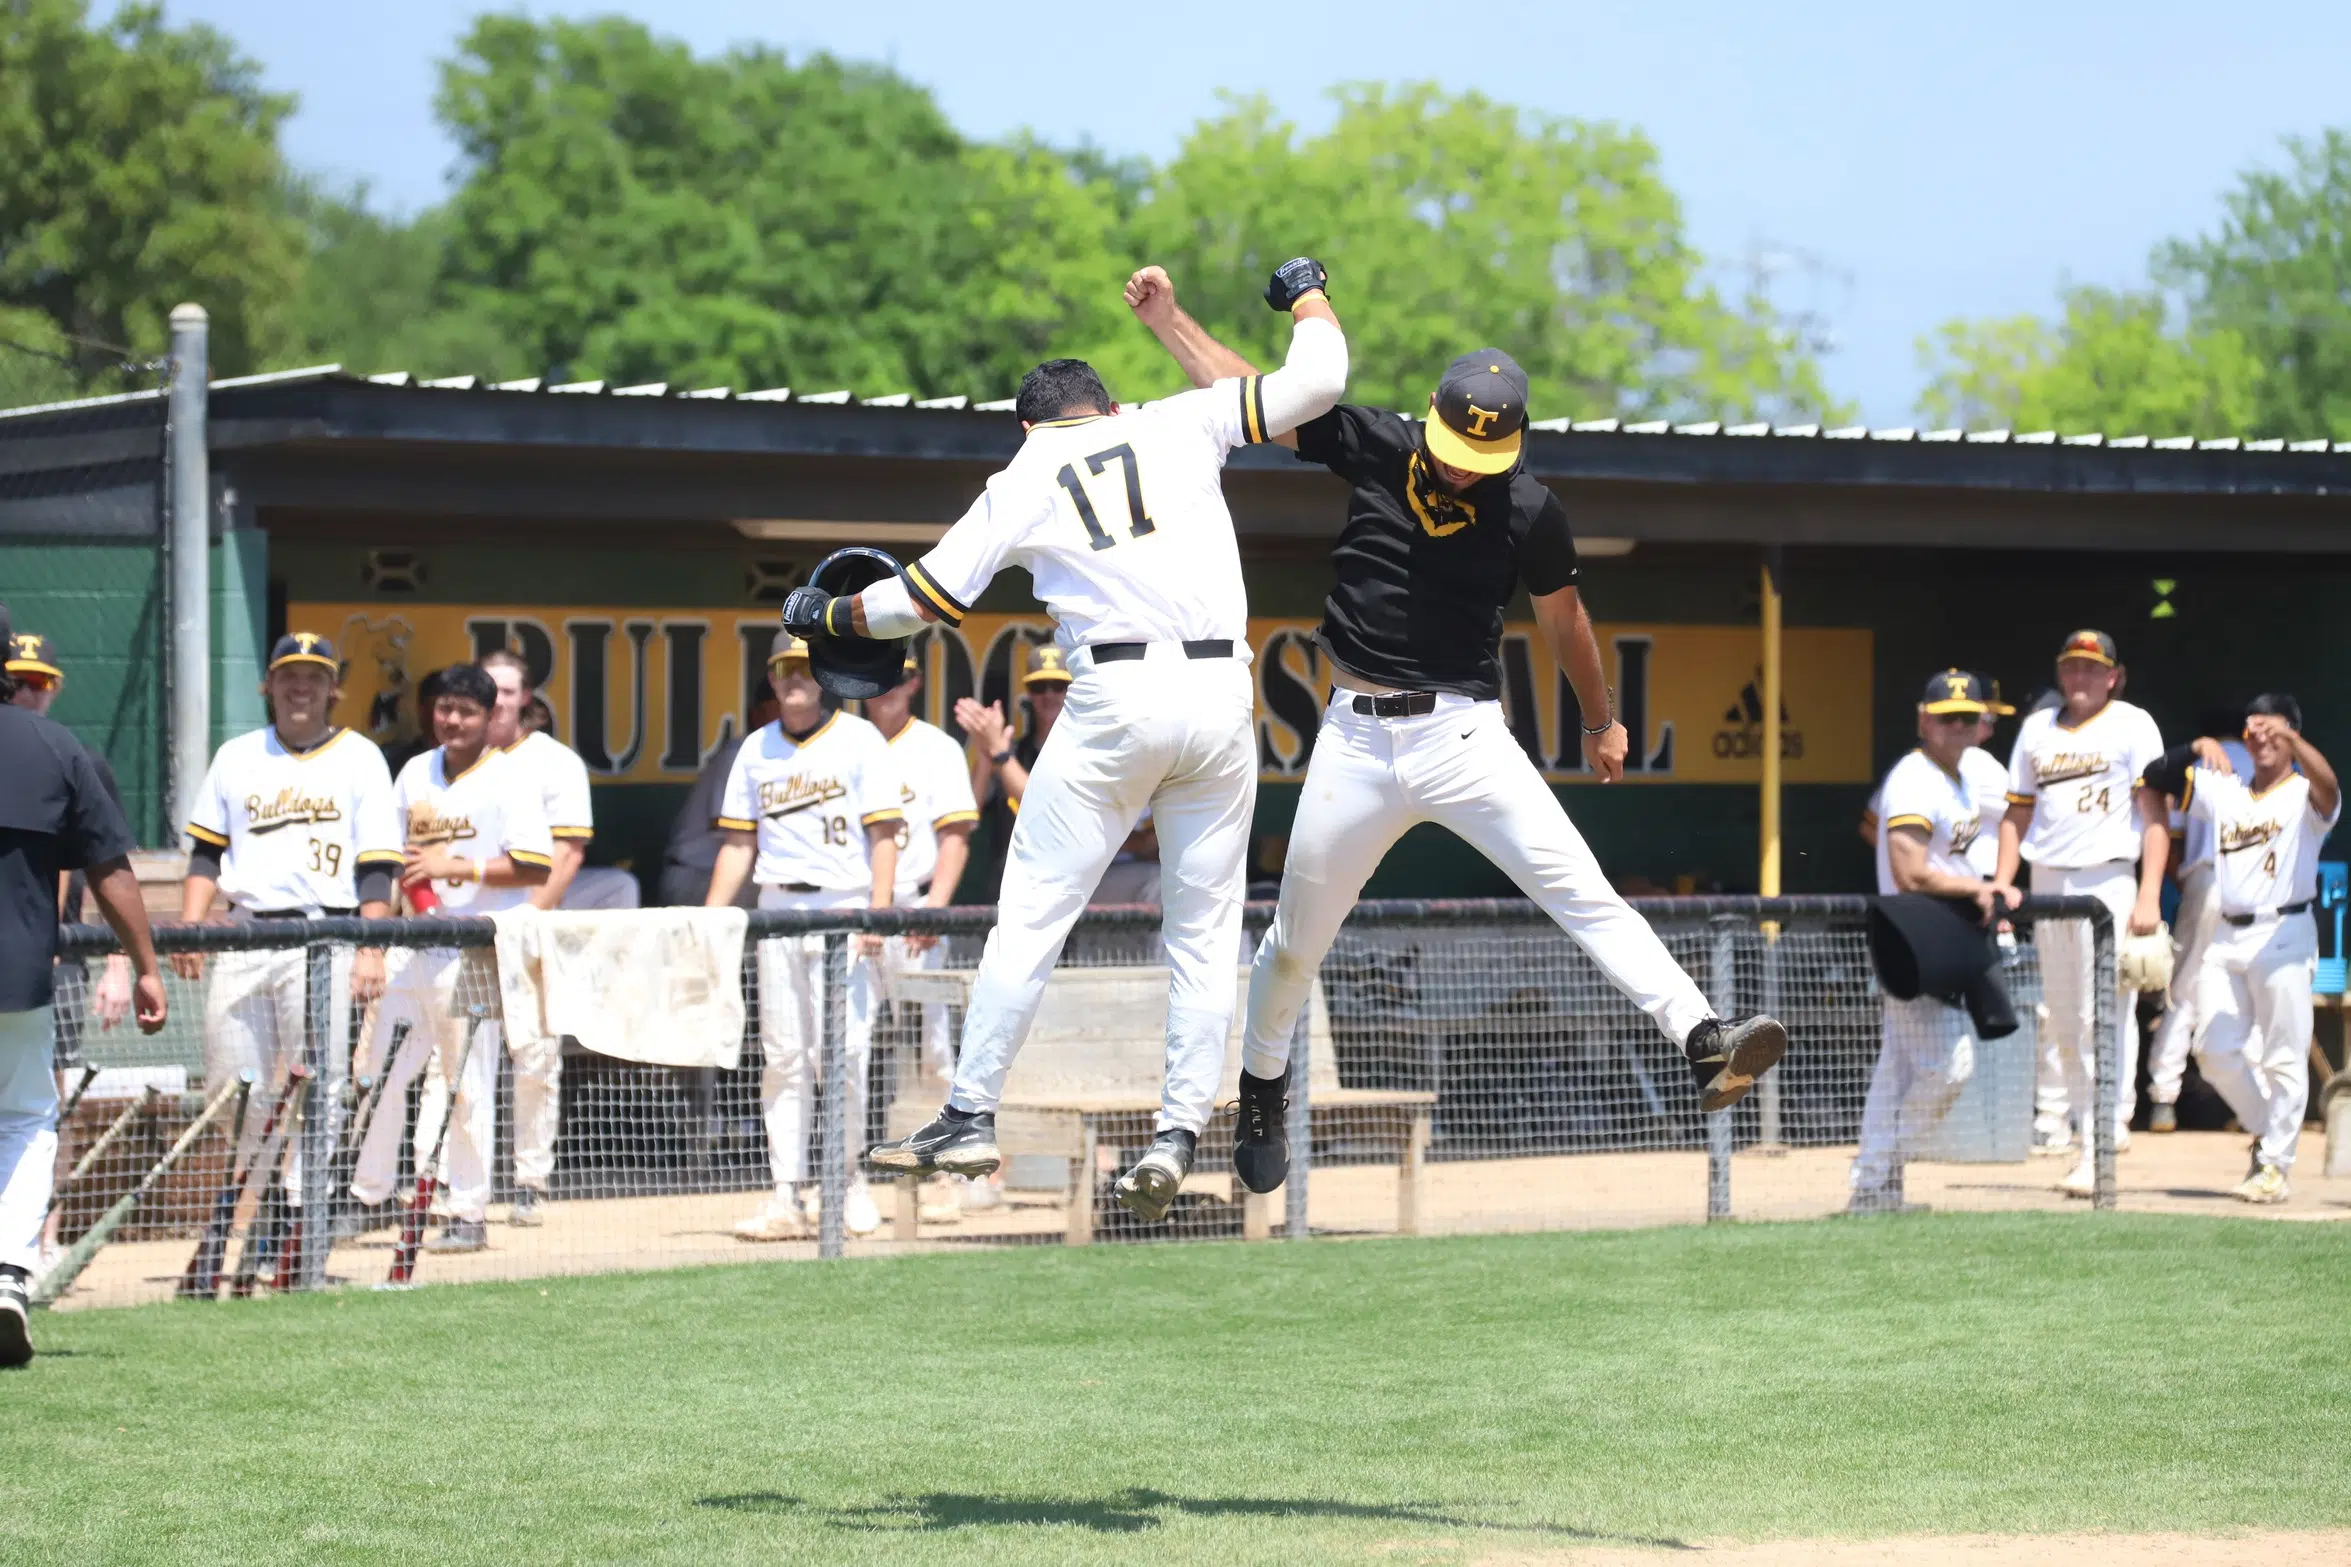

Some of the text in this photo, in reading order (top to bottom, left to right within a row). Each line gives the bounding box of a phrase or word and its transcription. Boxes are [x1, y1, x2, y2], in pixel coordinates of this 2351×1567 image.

[1467, 404, 1499, 437] T
[1056, 442, 1156, 551] 17
[17, 635, 41, 659] T
[295, 632, 319, 655] T
[1040, 648, 1061, 669] T
[1948, 677, 1969, 699] T
[245, 787, 341, 824] Bulldogs
[758, 773, 847, 809] Bulldogs
[2079, 785, 2109, 813] 24
[307, 837, 342, 877] 39
[2263, 850, 2276, 879] 4
